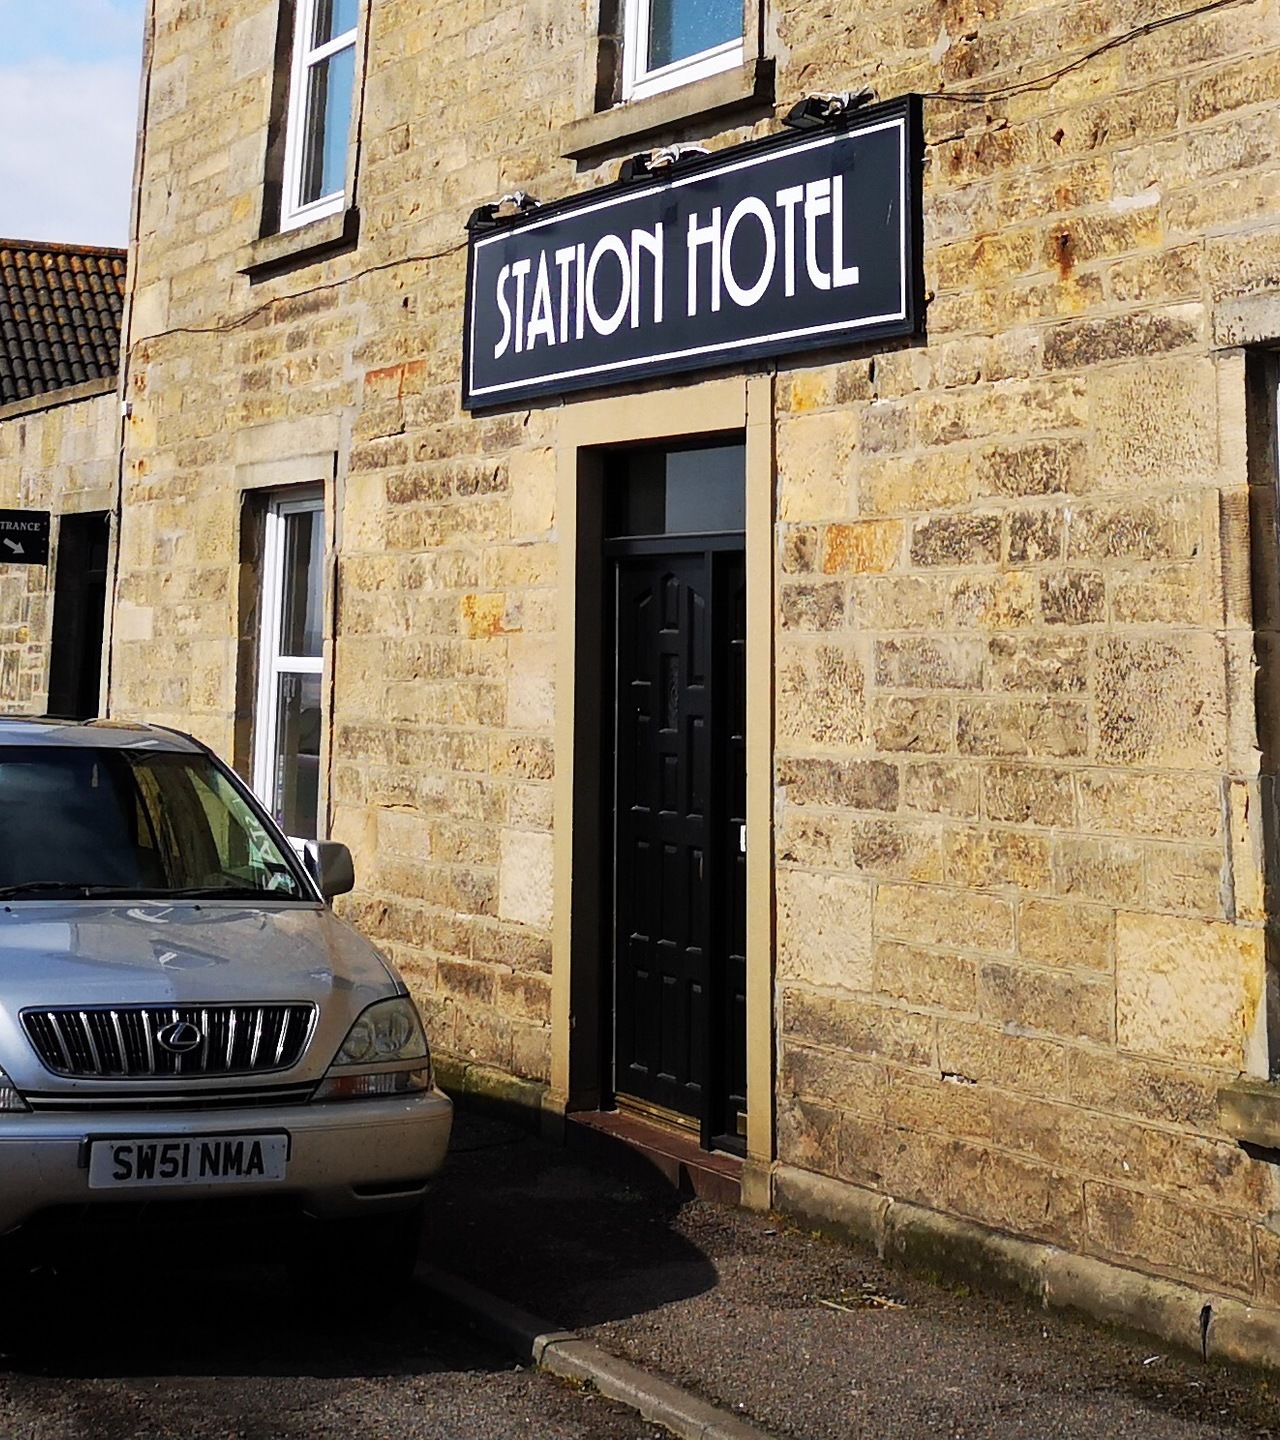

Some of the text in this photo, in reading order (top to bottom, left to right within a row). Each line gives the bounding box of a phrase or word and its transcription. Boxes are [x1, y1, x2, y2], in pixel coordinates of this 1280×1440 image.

[494, 175, 859, 359] STATION HOTEL
[113, 1141, 265, 1181] SW51 NMA
